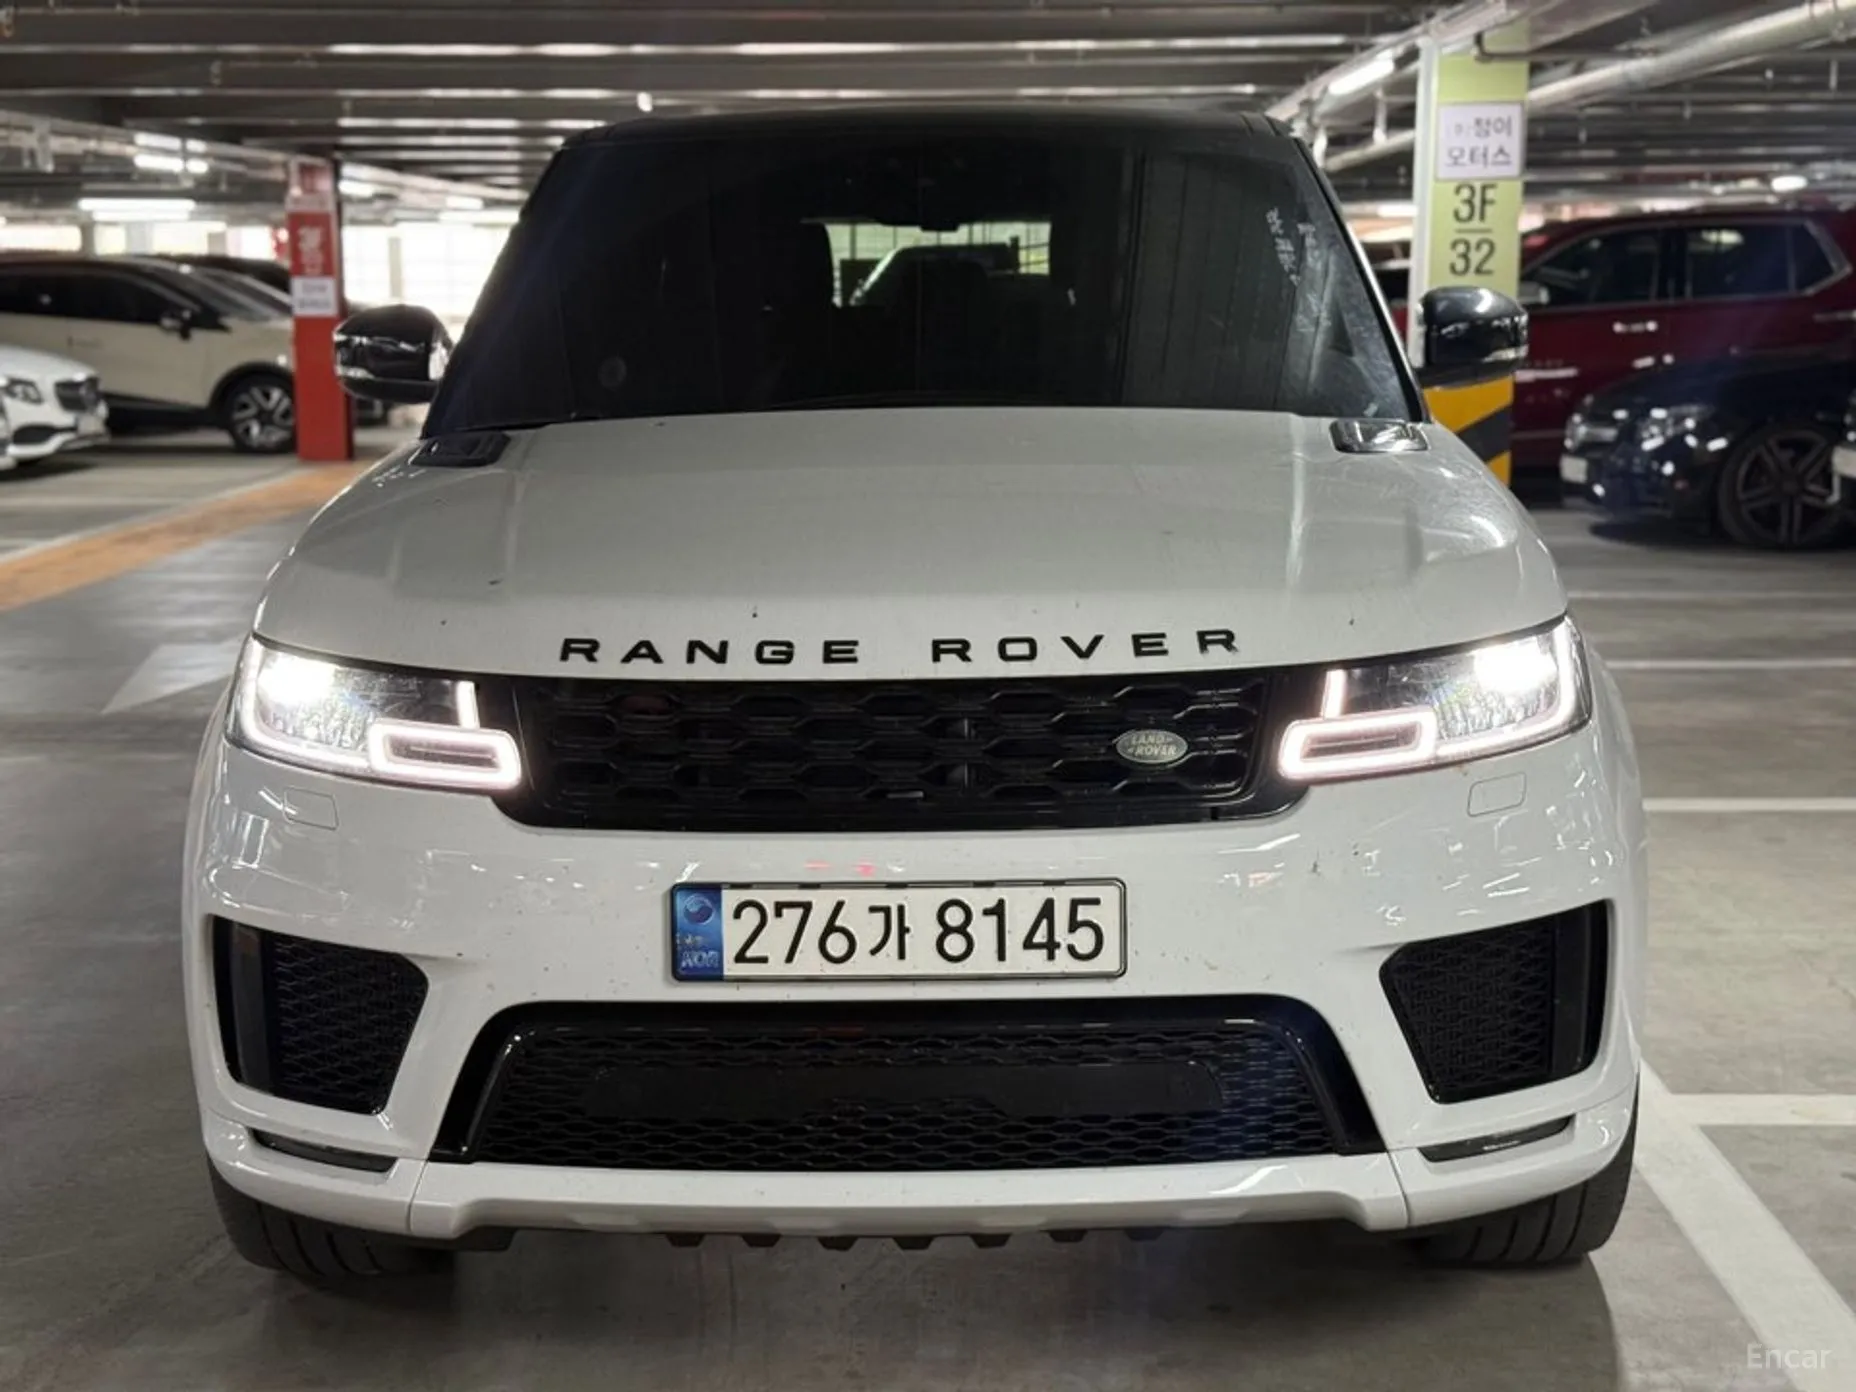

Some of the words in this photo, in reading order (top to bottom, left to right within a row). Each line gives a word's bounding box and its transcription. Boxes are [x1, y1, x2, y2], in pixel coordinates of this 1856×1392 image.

[1454, 183, 1498, 223] 3F
[1449, 237, 1496, 276] 32
[559, 638, 860, 665] RANGE
[931, 629, 1239, 663] ROVER
[732, 899, 911, 965] 276가
[935, 897, 1104, 963] 8145
